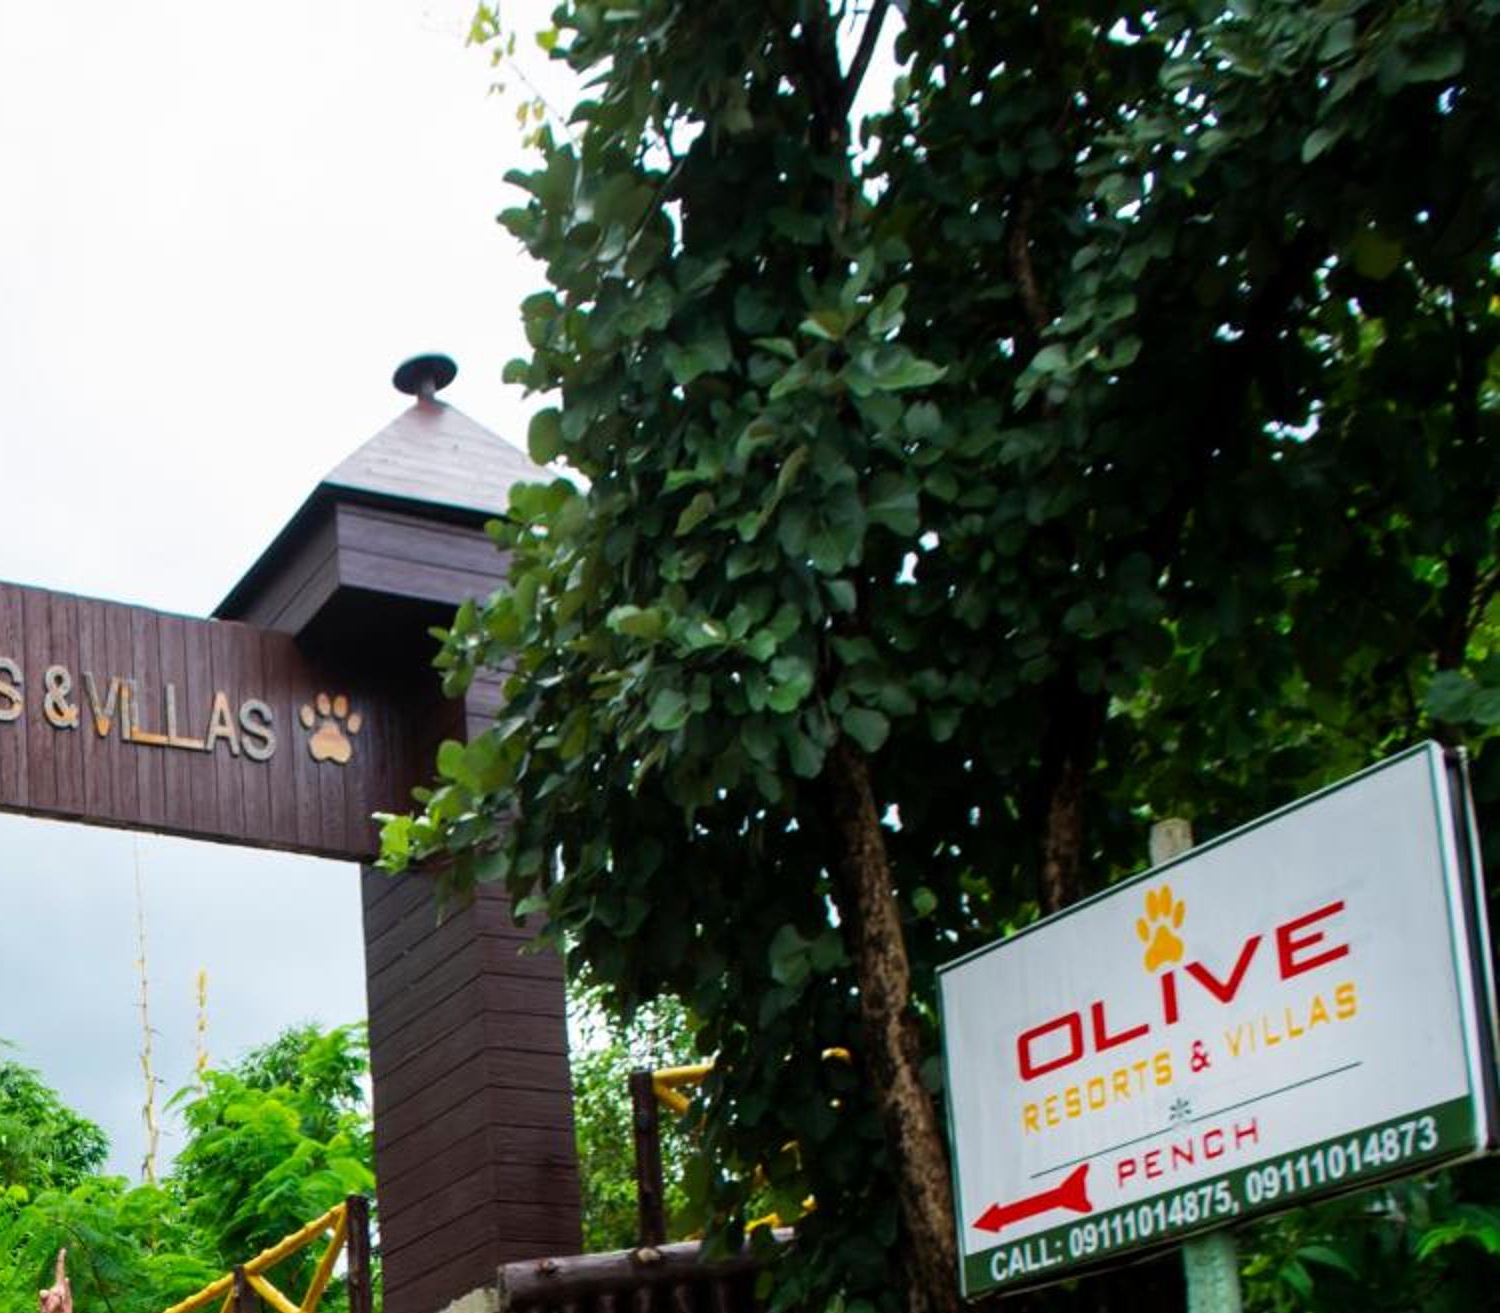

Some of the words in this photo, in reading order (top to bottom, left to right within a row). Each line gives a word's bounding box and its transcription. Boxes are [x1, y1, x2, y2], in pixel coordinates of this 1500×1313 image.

[44, 664, 80, 731] &
[84, 671, 277, 763] VILLAS
[1017, 900, 1351, 1082] OLIVE
[1022, 1050, 1174, 1136] RESORTS
[1188, 1040, 1212, 1073] &
[1224, 981, 1360, 1057] VILLAS
[990, 1236, 1064, 1282] CALL:
[1069, 1179, 1241, 1259] 09111014875,
[1245, 1114, 1440, 1204] 09111014873
[1117, 1117, 1261, 1188] PENCH
